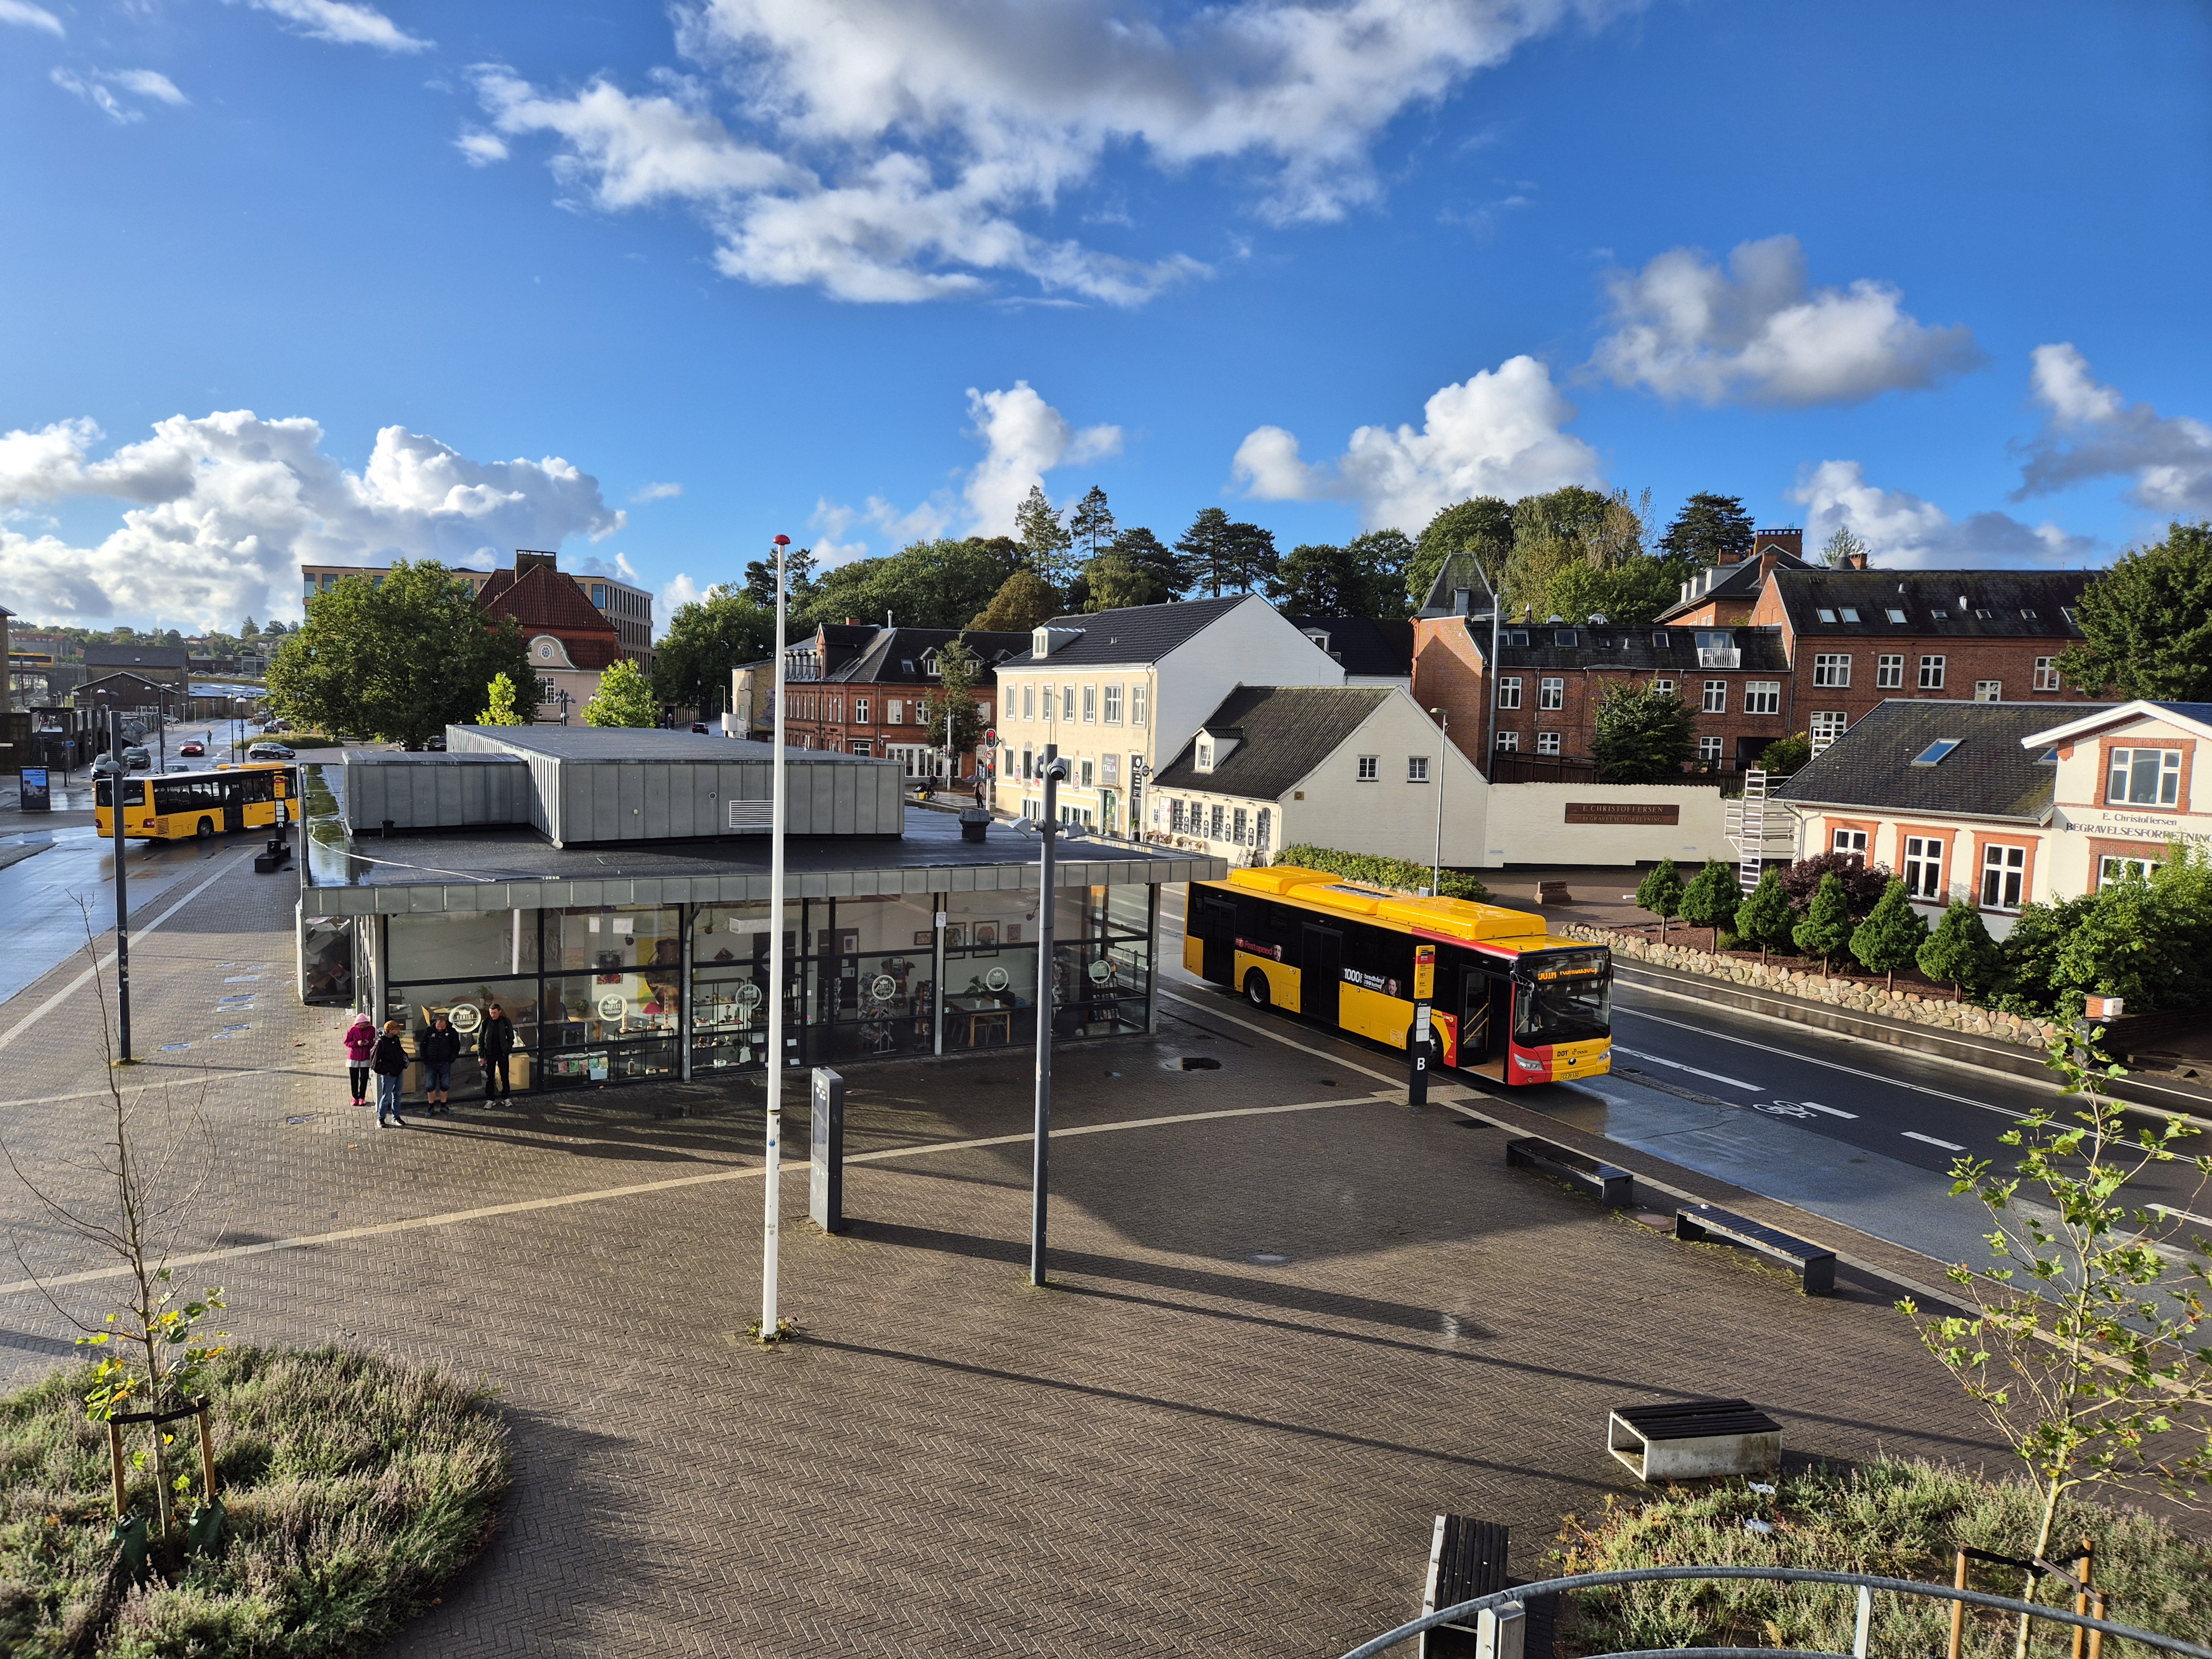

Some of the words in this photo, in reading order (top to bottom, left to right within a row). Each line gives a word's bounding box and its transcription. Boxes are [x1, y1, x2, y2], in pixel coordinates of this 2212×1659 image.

[1102, 764, 1116, 773] ITALIA
[2103, 812, 2111, 821] E.
[2114, 813, 2178, 826] Christoffersen
[1244, 940, 1273, 956] Fastspeed
[1344, 968, 1360, 983] 1000
[1417, 1057, 1426, 1071] B
